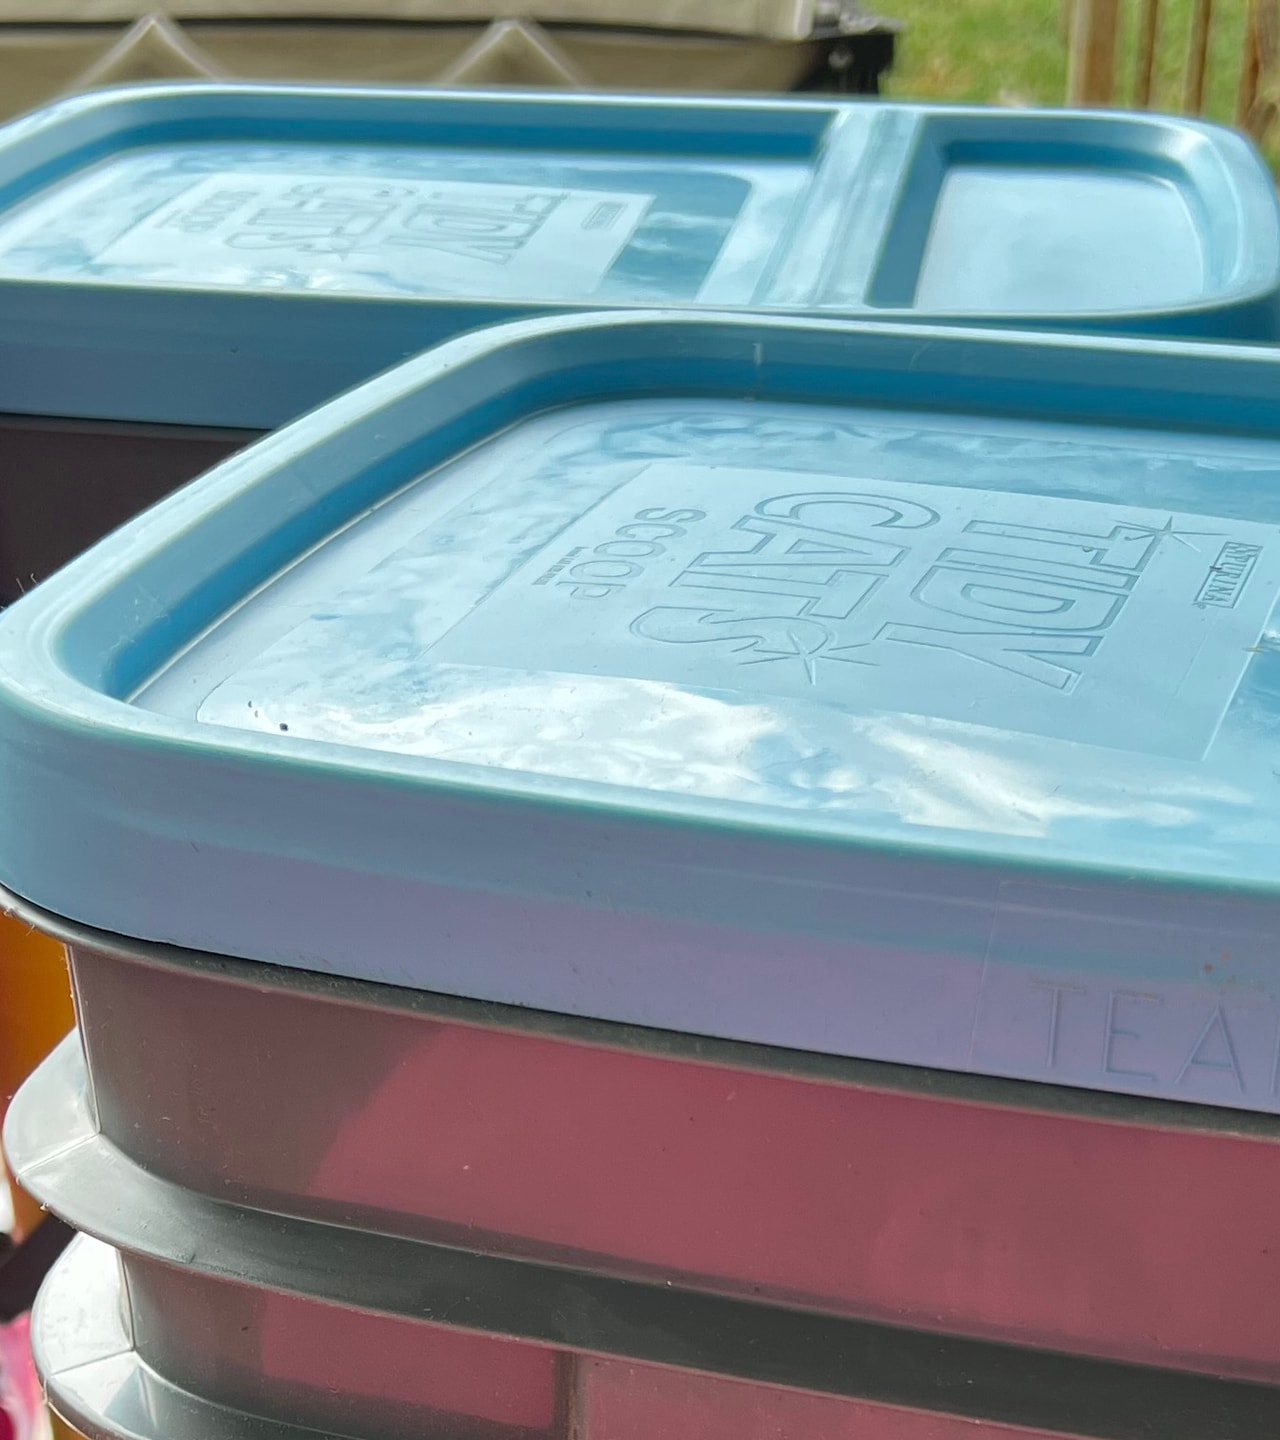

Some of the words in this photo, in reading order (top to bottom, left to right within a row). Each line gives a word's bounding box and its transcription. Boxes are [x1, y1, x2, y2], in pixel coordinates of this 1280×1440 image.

[556, 507, 708, 601] SCOOP
[629, 492, 941, 656] CATS
[873, 519, 1163, 695] TIDY
